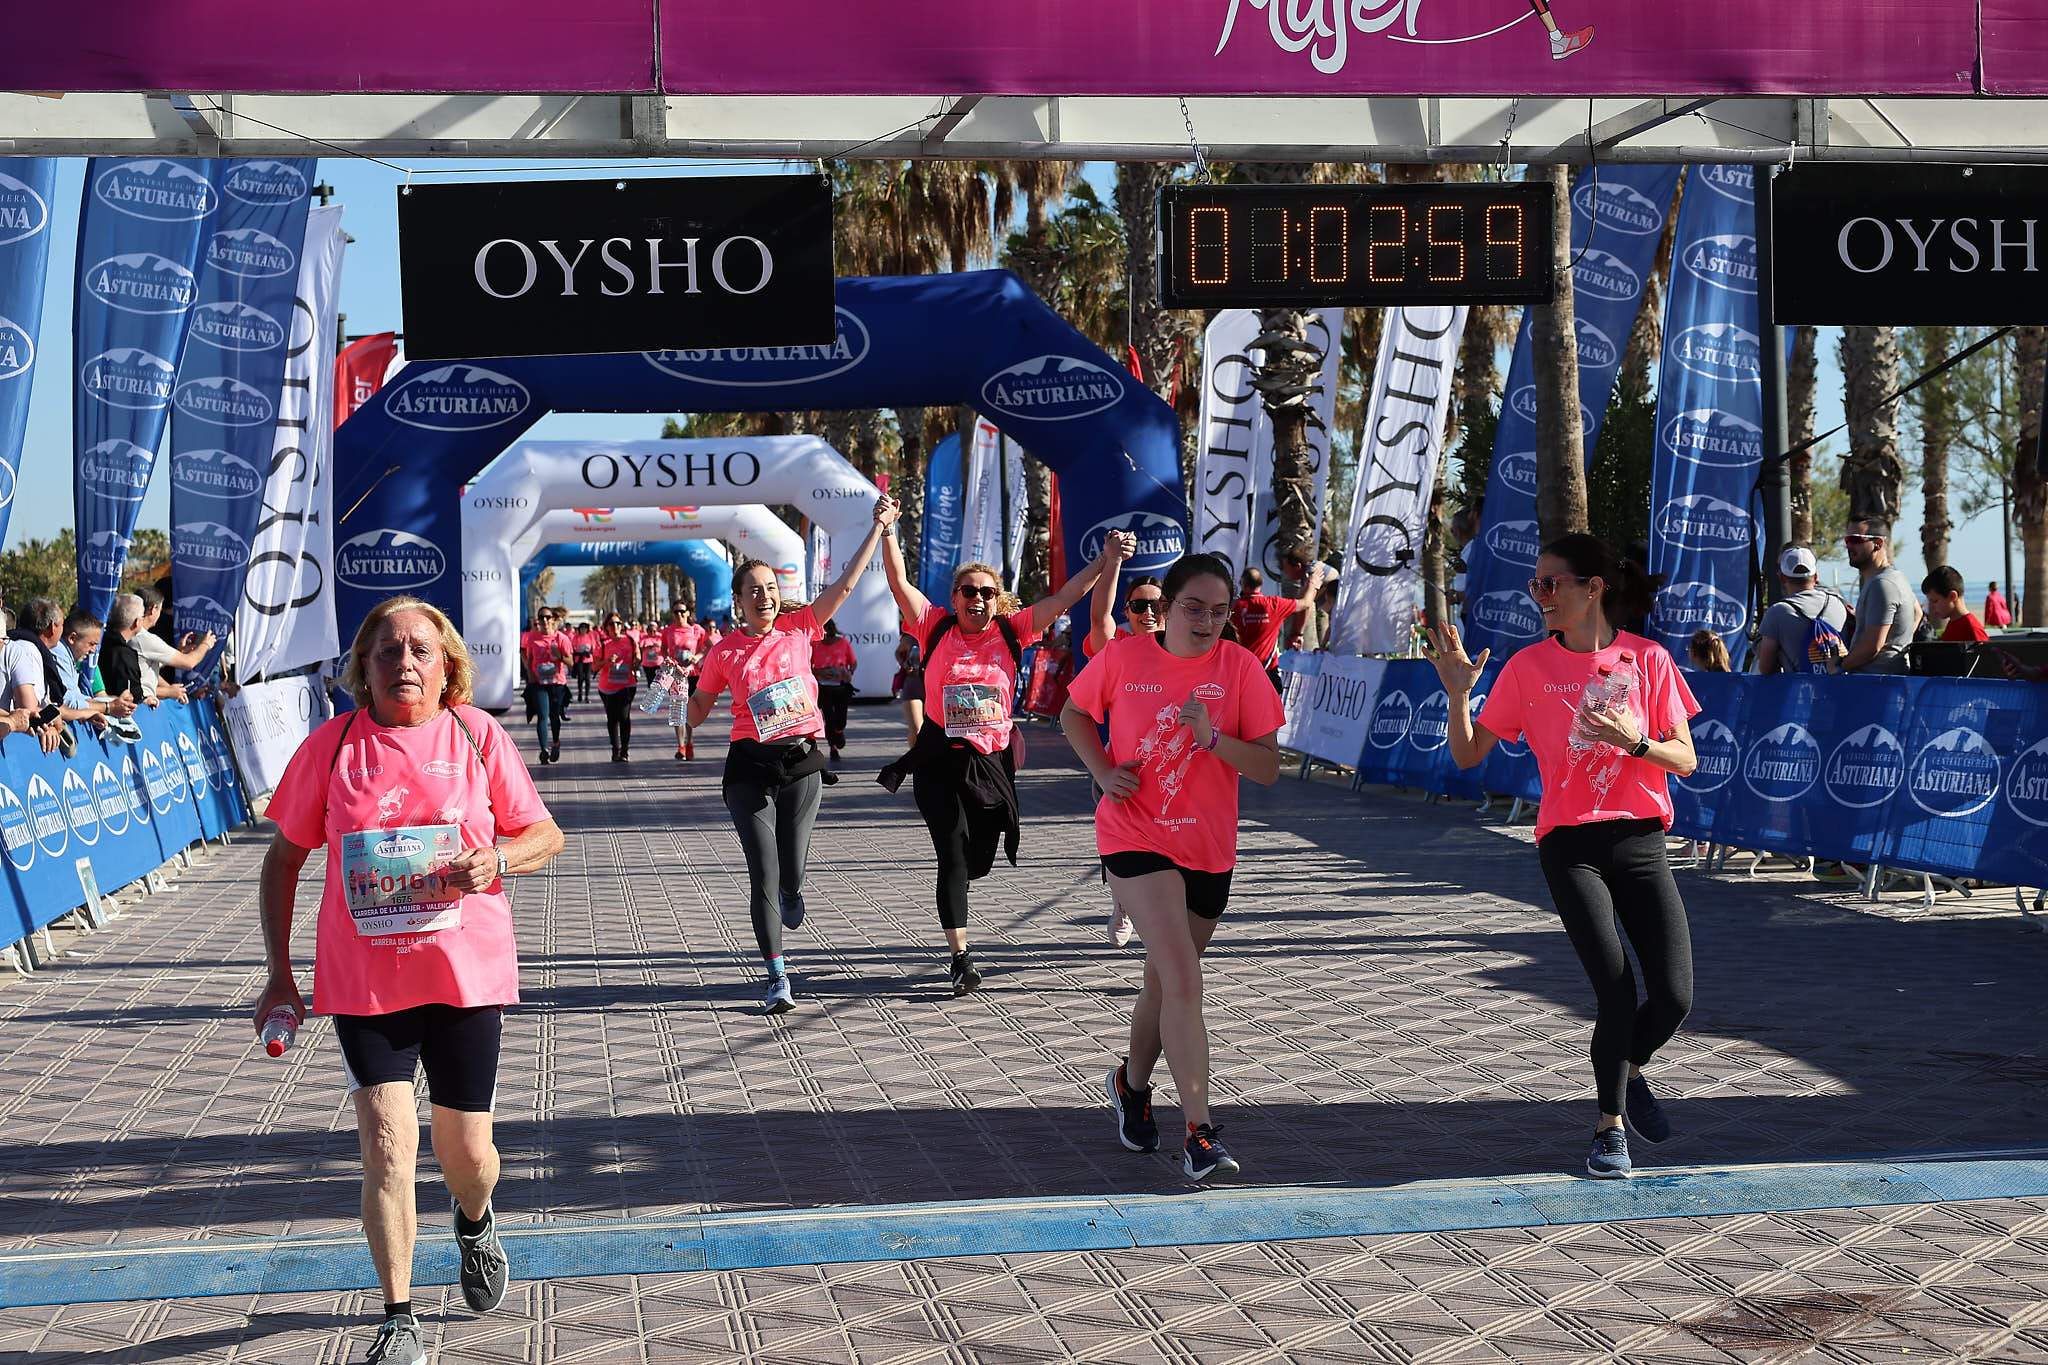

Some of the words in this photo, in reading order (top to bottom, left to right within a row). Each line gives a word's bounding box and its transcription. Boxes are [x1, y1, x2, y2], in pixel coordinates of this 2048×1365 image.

[104, 175, 207, 212] ASTURIANA
[1191, 205, 1523, 285] 01:02:59
[1838, 217, 2040, 273] OYSH
[474, 235, 773, 299] OYSHO
[95, 269, 191, 304] ASTURIANA
[191, 314, 276, 344] ASTURIANA
[180, 388, 266, 420] ASTURIANA
[393, 389, 520, 415] ASTURIANA
[995, 384, 1117, 406] ASTURIANA
[173, 461, 254, 492] ASTURIANA
[581, 451, 761, 490] OYSHO
[474, 496, 528, 509] OYSHO
[813, 487, 865, 500] OYSHO
[1087, 536, 1182, 559] ARIANA
[340, 554, 439, 577] ASTURIANA
[1124, 682, 1163, 693] OYSHO
[1313, 672, 1367, 721] OYSHO
[1543, 682, 1581, 693] OYSHO
[1748, 751, 1815, 783] ASTURIANA
[1828, 753, 1897, 788] ASTURIANA
[1912, 757, 1991, 796] ASTURIANA
[377, 845, 422, 855] ASTURIANA
[354, 910, 379, 918] CARRERA
[399, 904, 421, 913] MUJER
[361, 919, 393, 930] OYSHO
[371, 938, 398, 946] CARRERA
